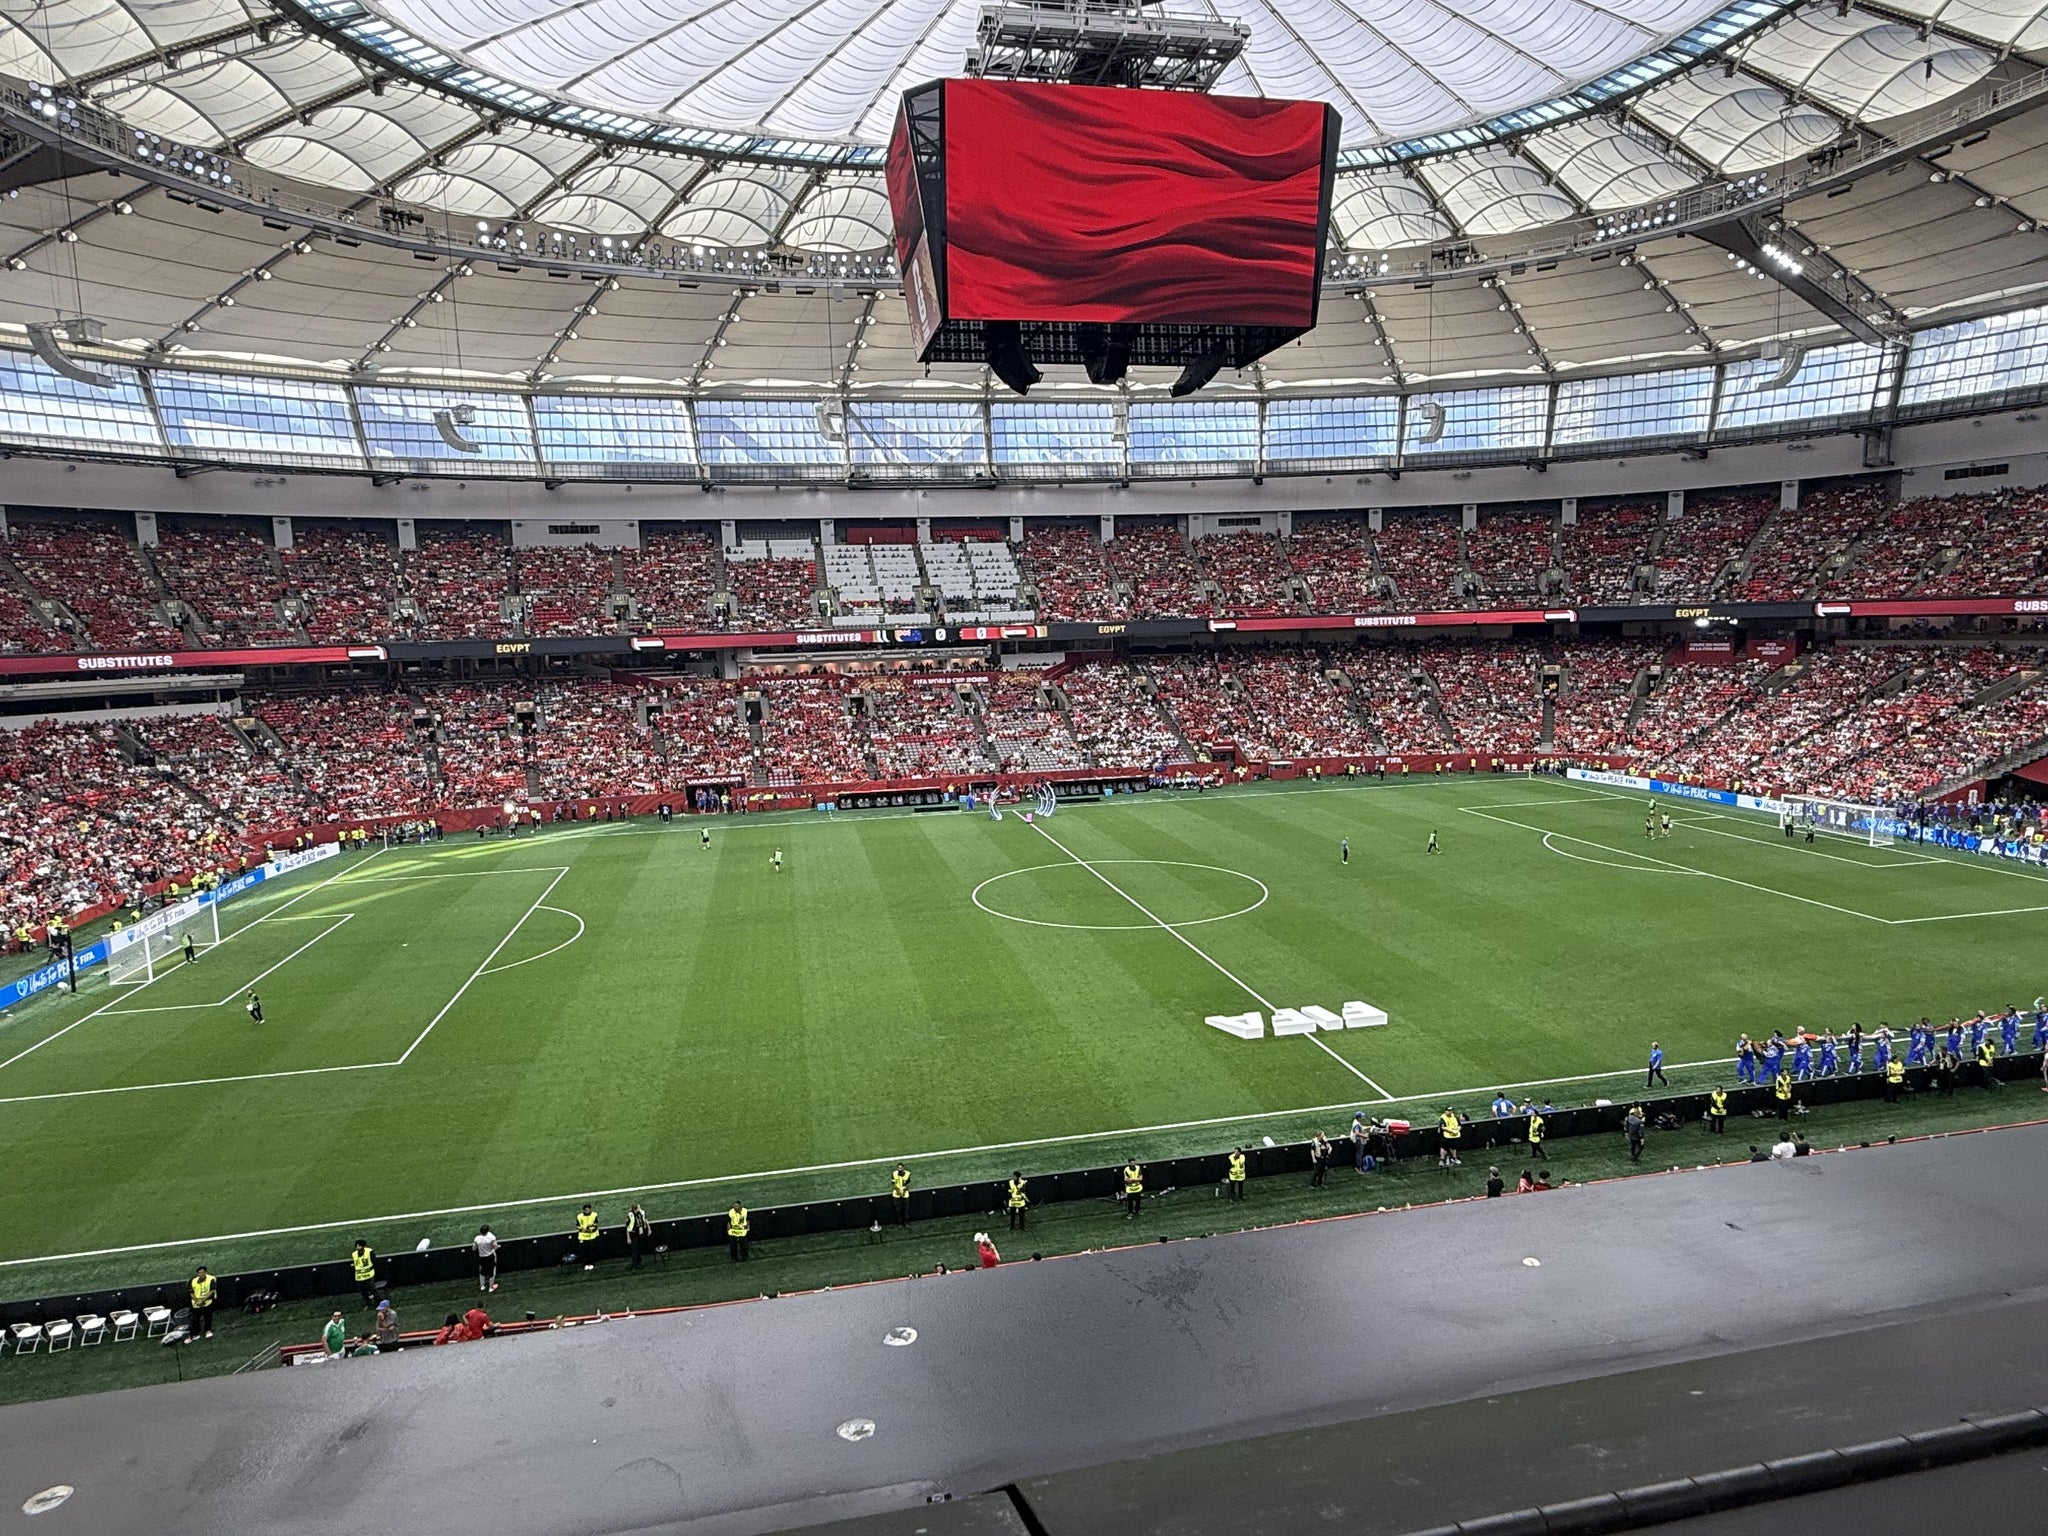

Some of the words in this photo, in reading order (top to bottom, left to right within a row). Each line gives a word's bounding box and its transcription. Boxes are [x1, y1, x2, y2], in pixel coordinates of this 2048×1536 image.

[1675, 608, 1710, 618] EGYPT
[1354, 615, 1417, 627] SUBSTITUTES
[1098, 624, 1126, 634] EGYPT
[796, 633, 862, 644] SUBSTITUTES
[496, 643, 531, 654] EGYPT
[77, 655, 174, 670] SUBSTITUTES
[687, 776, 742, 786] VANCOUVER
[1691, 787, 1708, 800] PEACE
[80, 950, 95, 965] FIFA
